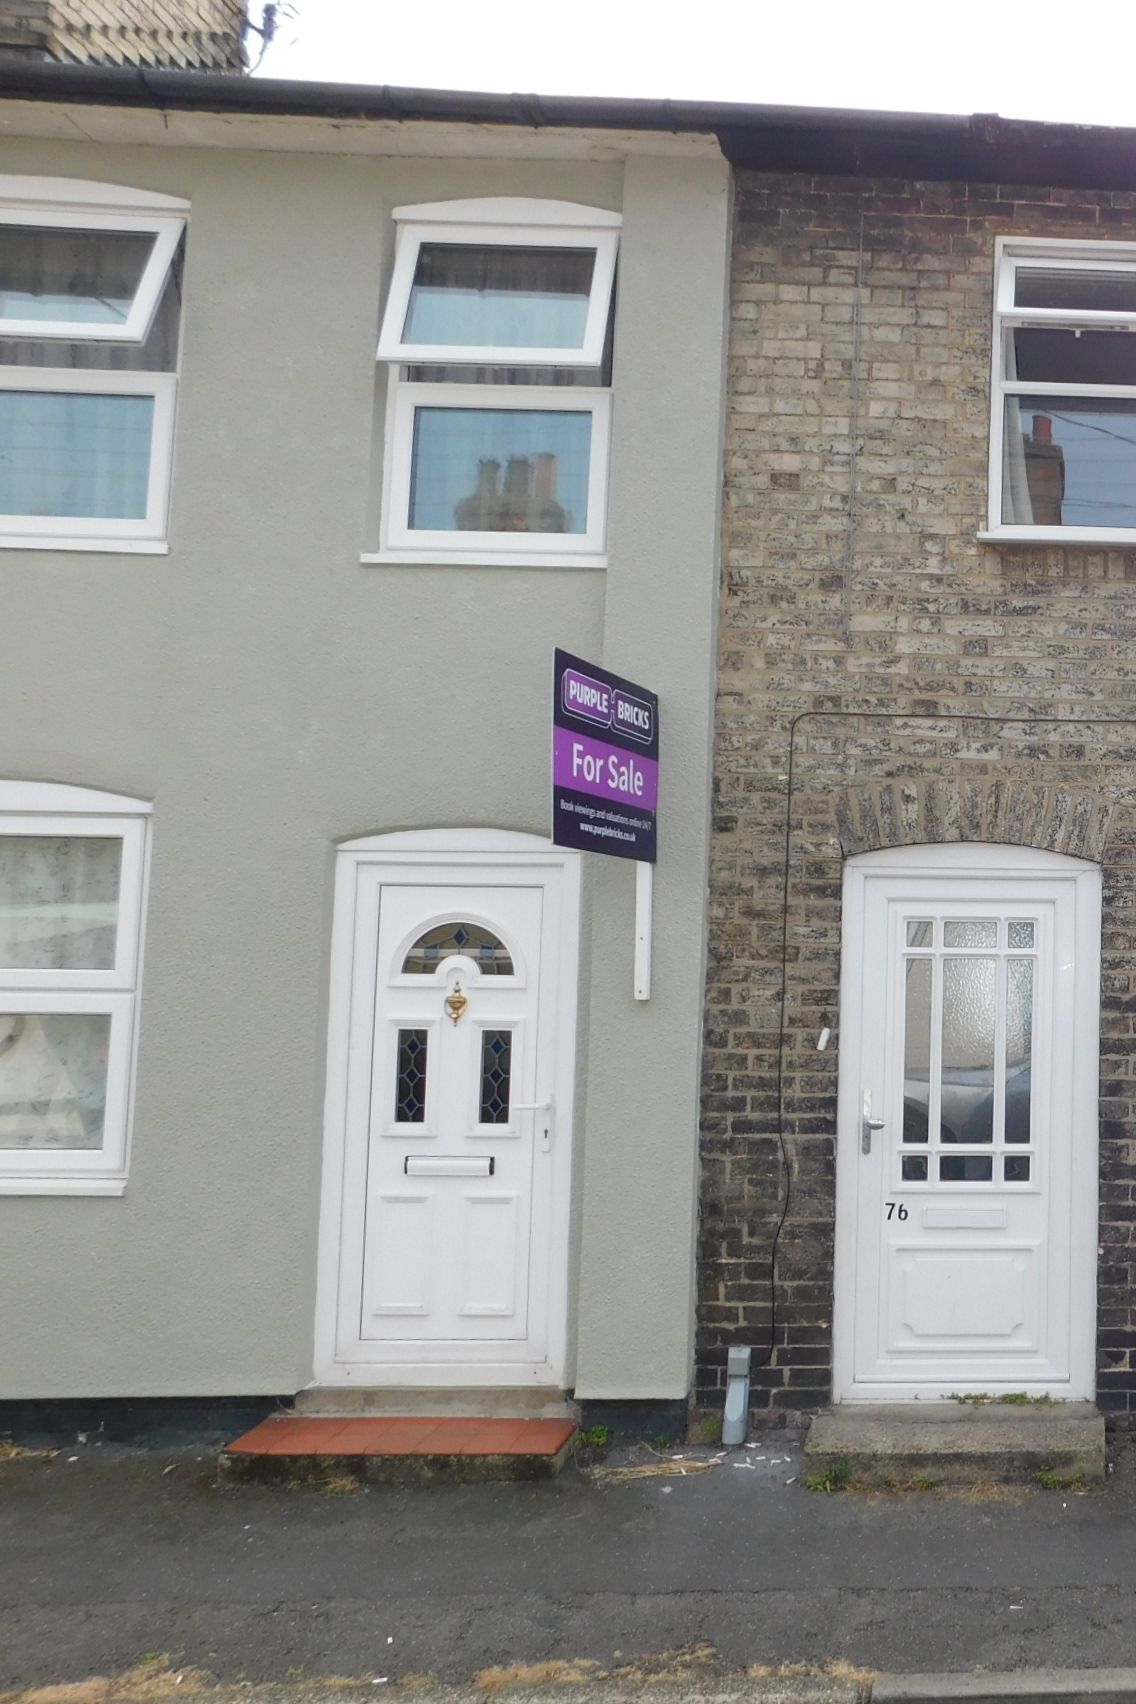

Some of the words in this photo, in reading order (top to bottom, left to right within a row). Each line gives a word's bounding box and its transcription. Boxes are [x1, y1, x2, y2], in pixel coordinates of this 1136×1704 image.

[569, 680, 609, 713] PURPLE
[617, 700, 649, 729] BRICKS
[573, 742, 604, 784] For
[608, 755, 643, 796] Sale
[560, 799, 574, 811] Book
[596, 809, 606, 819] and
[579, 822, 637, 842] www.purplebricks.co.uk
[885, 1202, 909, 1221] 76
